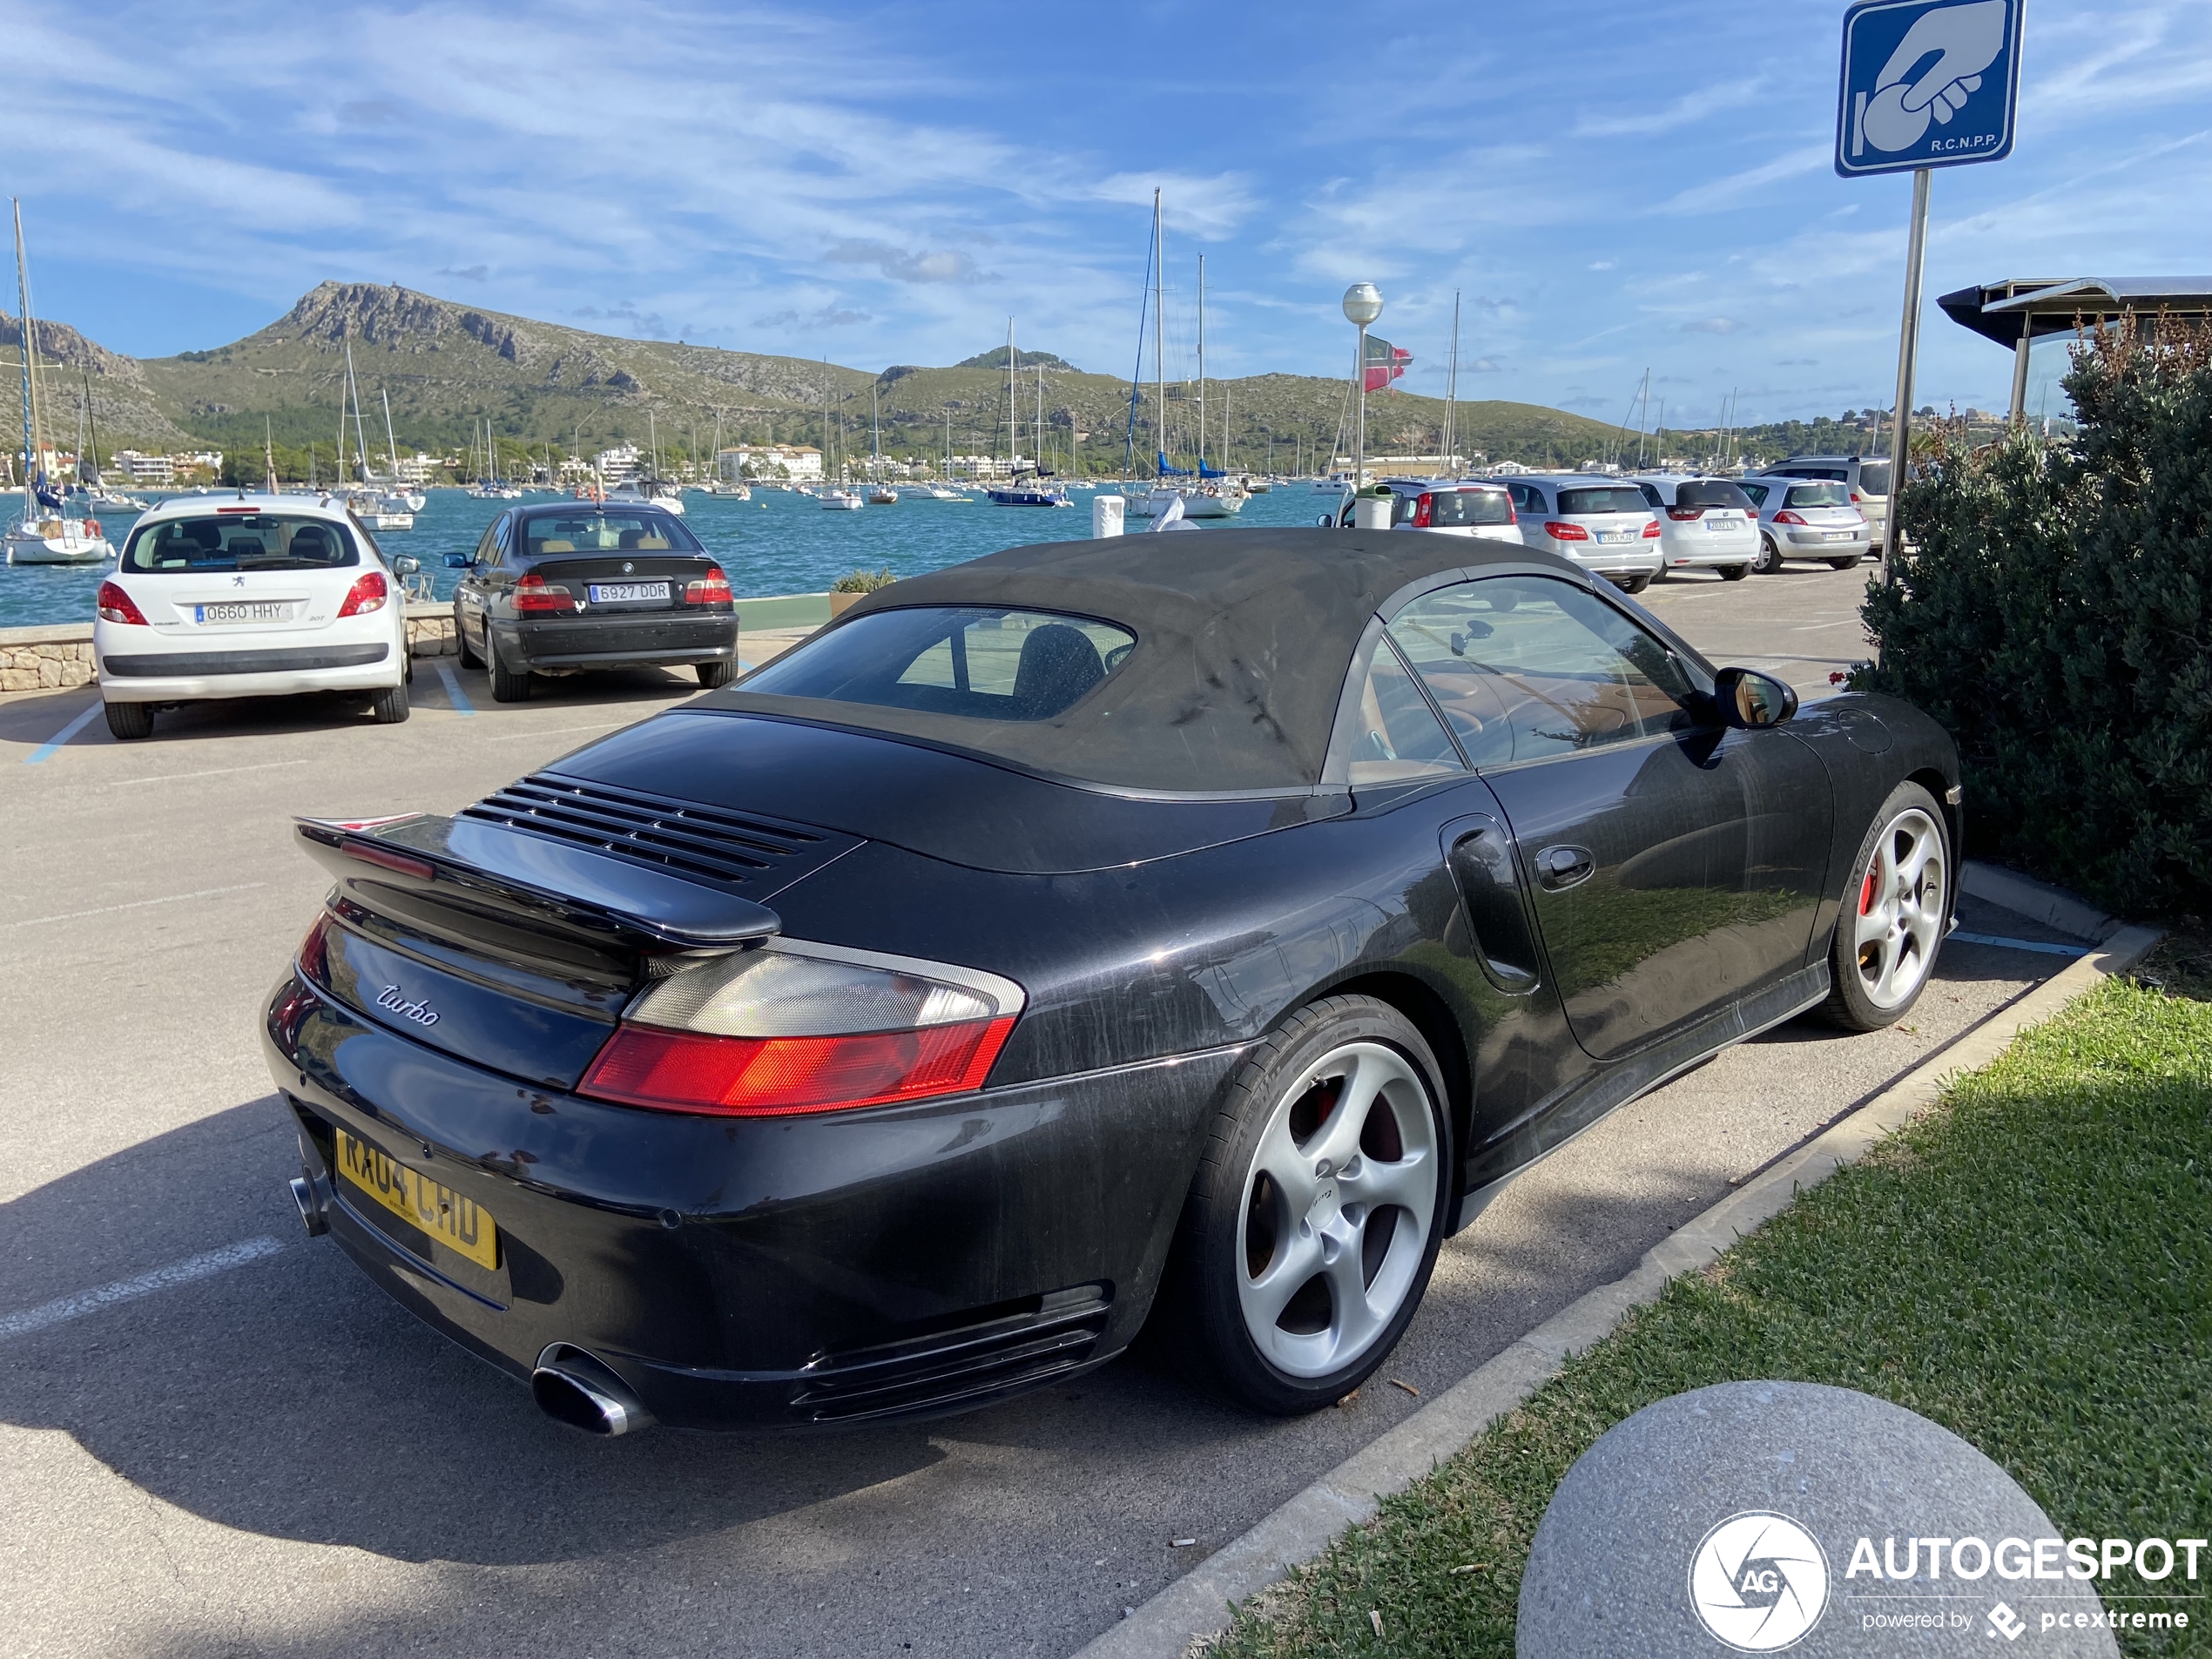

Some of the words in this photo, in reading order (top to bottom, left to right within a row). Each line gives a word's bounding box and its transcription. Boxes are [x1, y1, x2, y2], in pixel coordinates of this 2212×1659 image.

[1931, 134, 1997, 152] R.C.N.P.P.
[601, 586, 635, 599] 6927
[640, 584, 666, 597] DDR
[207, 605, 247, 620] 0660
[253, 604, 281, 618] HHY
[376, 984, 440, 1027] turbo
[346, 1134, 408, 1207] RX04
